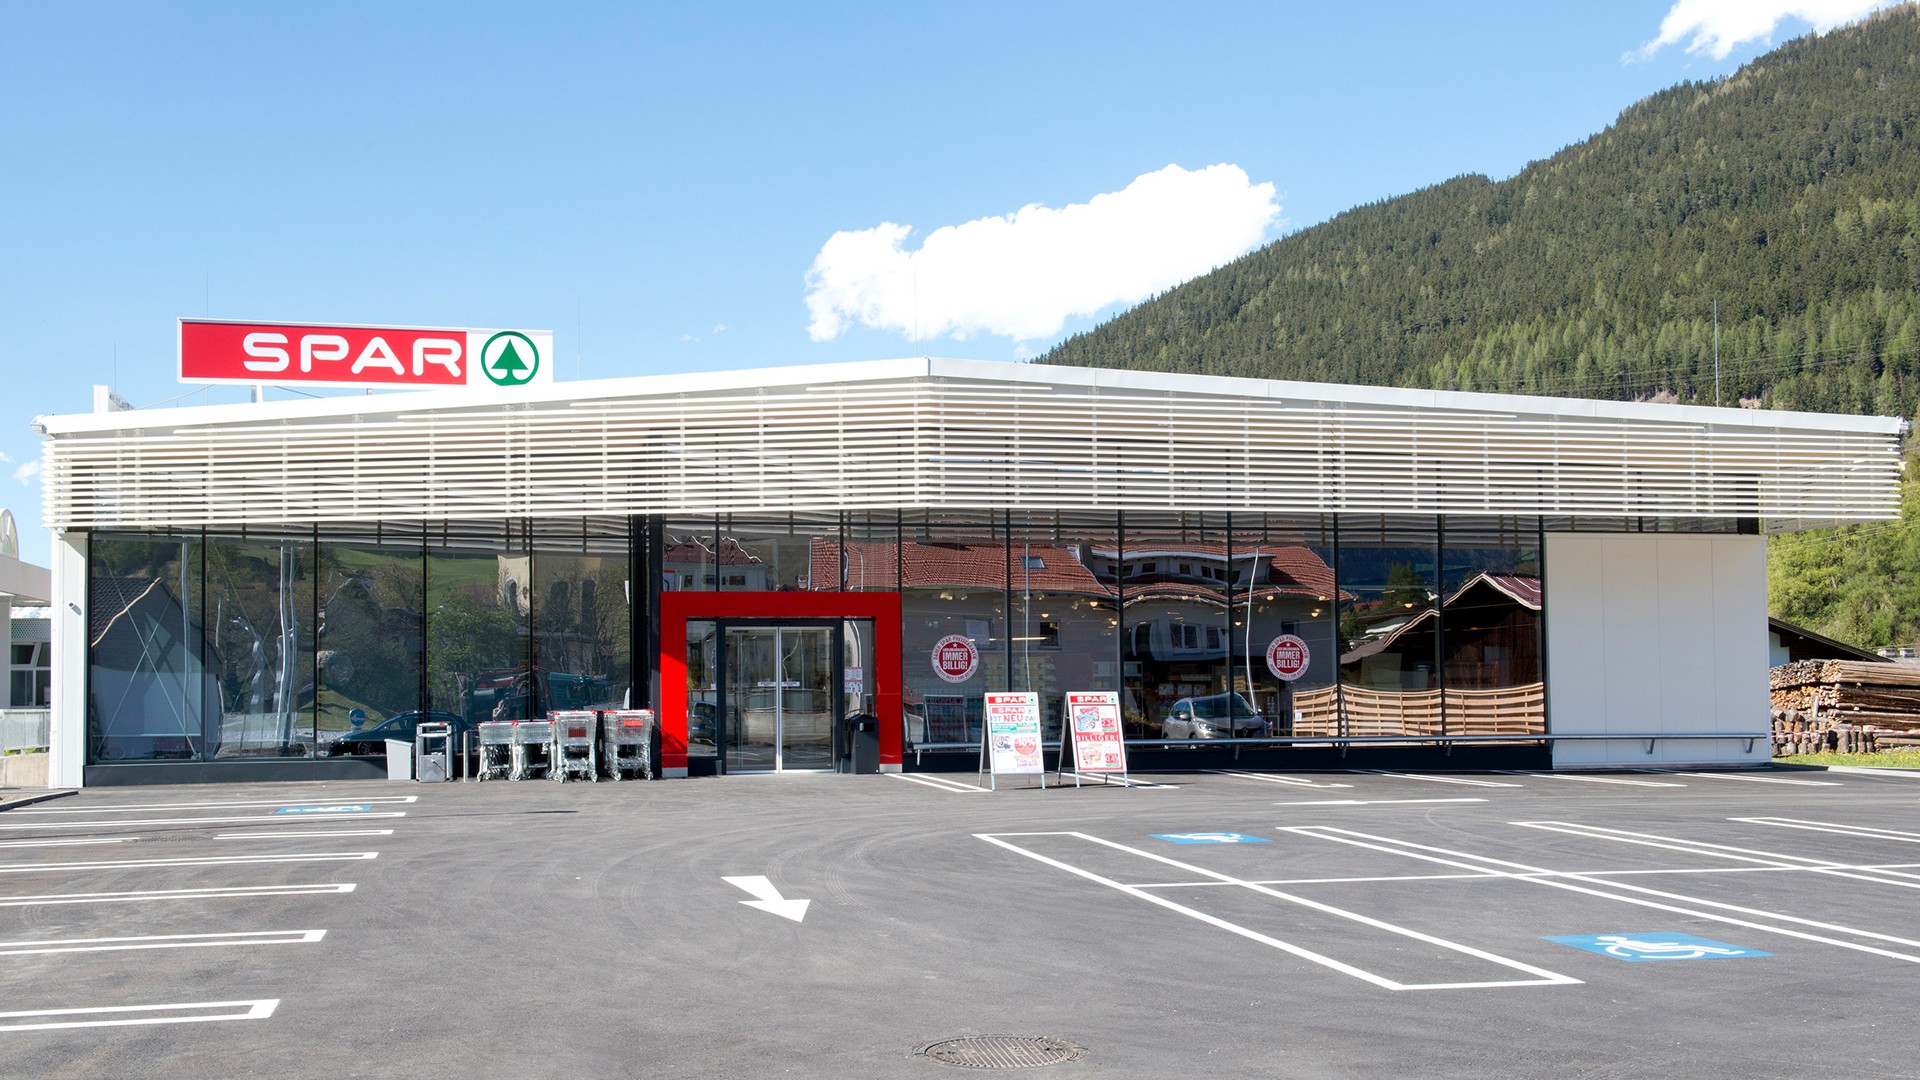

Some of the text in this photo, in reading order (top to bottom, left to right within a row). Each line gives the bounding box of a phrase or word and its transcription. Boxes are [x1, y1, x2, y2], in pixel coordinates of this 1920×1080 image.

[243, 332, 462, 378] SPAR
[942, 652, 968, 660] IMMER
[1276, 651, 1301, 659] IMMER
[942, 661, 968, 670] BILLIG!
[1276, 659, 1300, 668] BILLIG!
[1015, 737, 1036, 747] -10%
[1076, 734, 1119, 742] BILLIGER!
